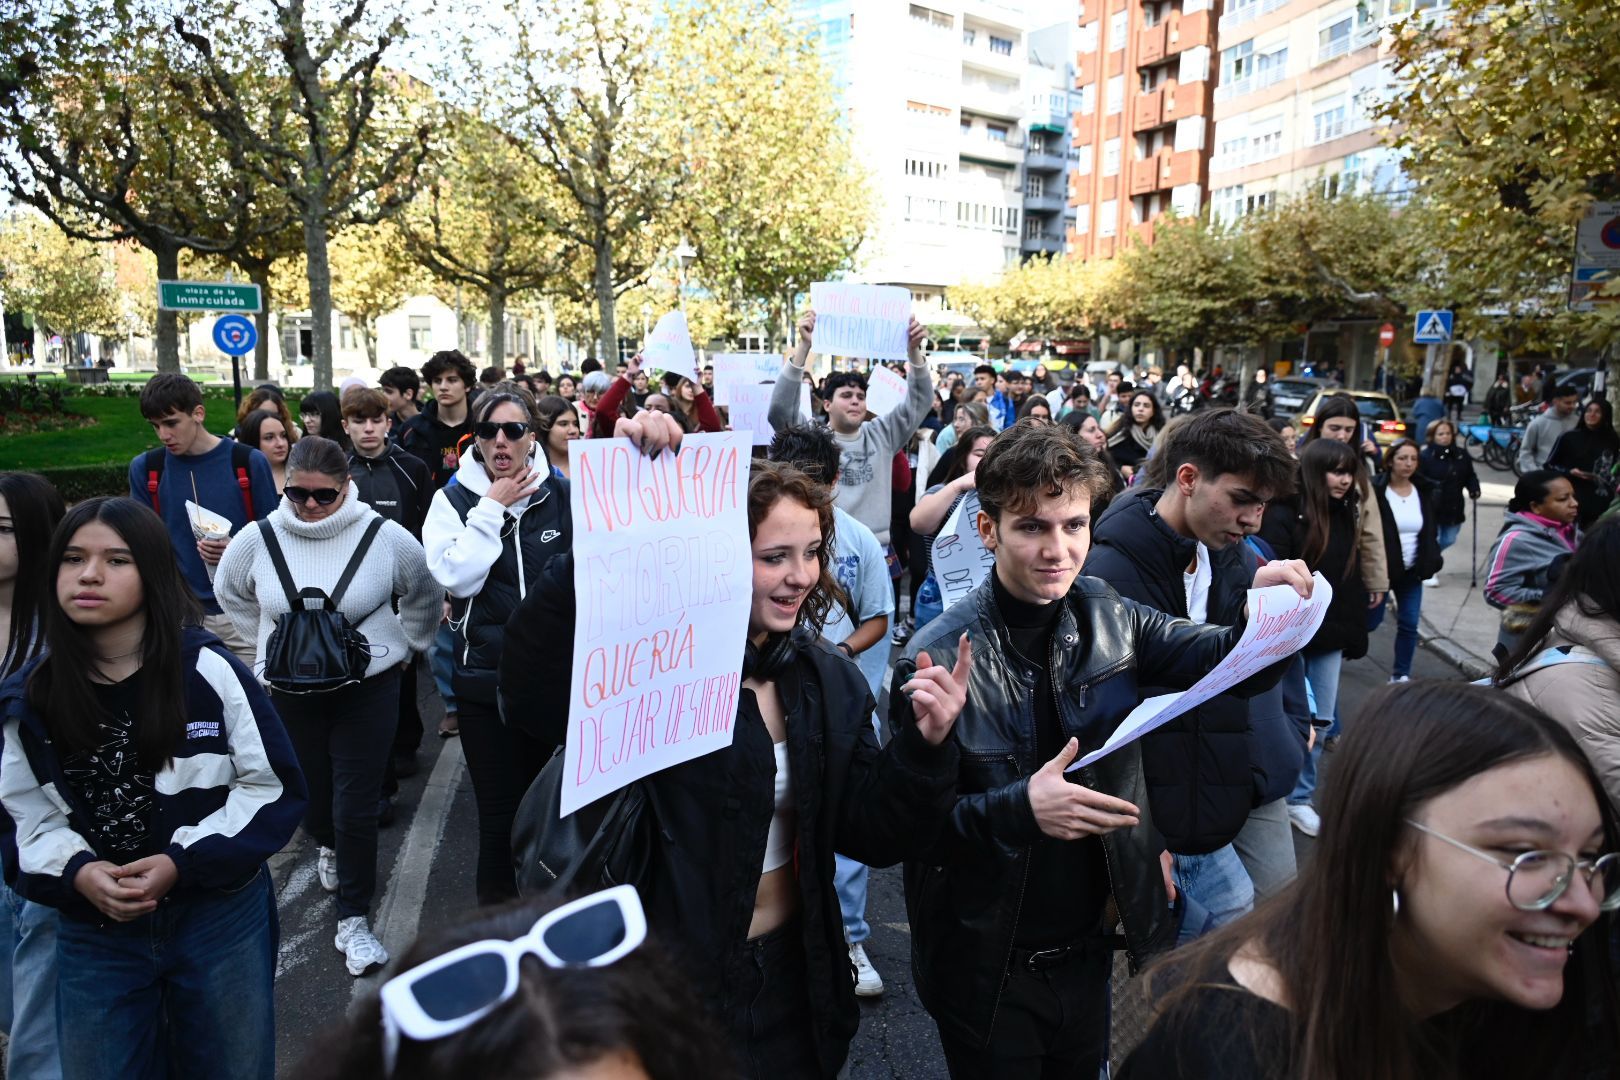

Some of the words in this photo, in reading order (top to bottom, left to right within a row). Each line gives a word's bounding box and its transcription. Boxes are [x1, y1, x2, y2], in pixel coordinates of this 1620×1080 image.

[177, 295, 245, 306] Inmaculada
[816, 313, 892, 353] TOLERANCIA
[579, 447, 634, 532] NO
[636, 435, 738, 522] QUERÍA
[586, 529, 737, 643] MORIR
[583, 611, 696, 709] QUERÍA
[187, 721, 219, 731] ONTROLLED
[576, 688, 663, 787] DEJAR
[664, 682, 693, 745] DE
[687, 671, 739, 740] SUFRIR
